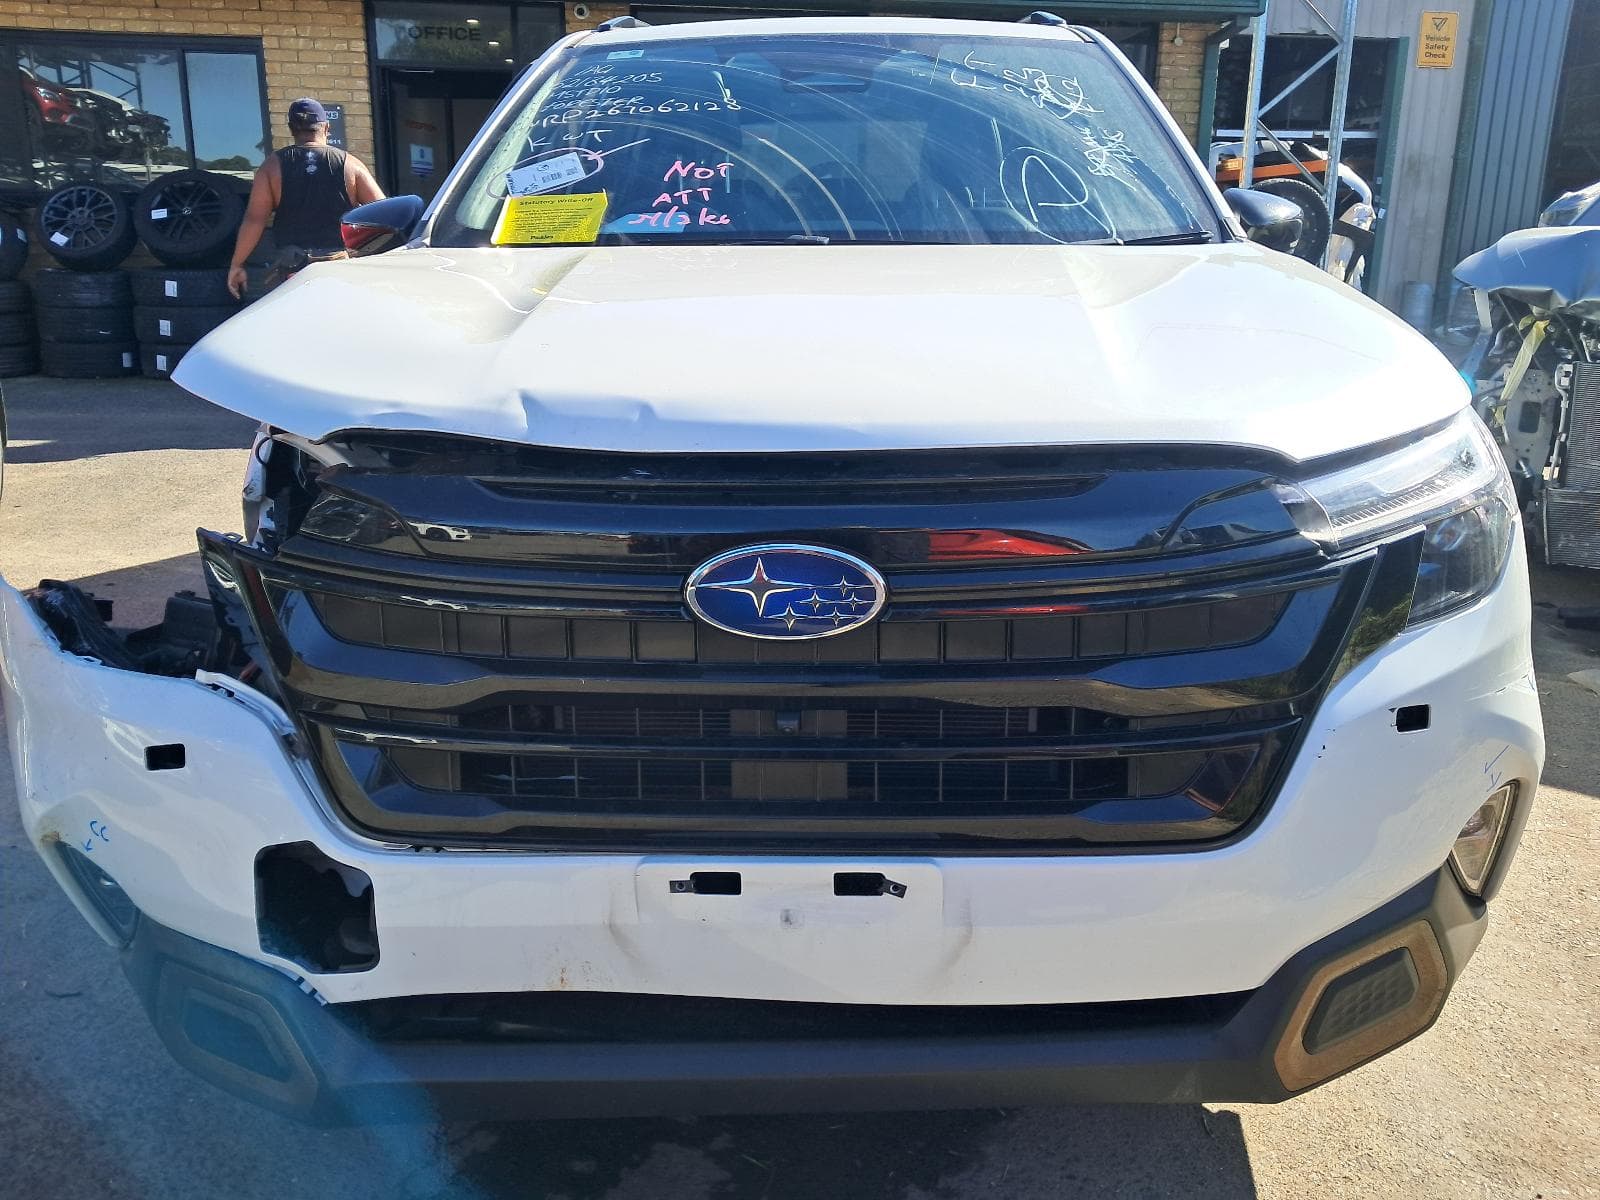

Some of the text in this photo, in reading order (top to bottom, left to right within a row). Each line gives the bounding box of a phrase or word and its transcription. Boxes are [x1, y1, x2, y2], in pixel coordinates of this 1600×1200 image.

[407, 26, 482, 40] OFFICE
[1425, 34, 1451, 42] Vehicle
[1425, 43, 1449, 51] Safety
[1424, 51, 1447, 59] Check
[652, 187, 712, 207] ATT
